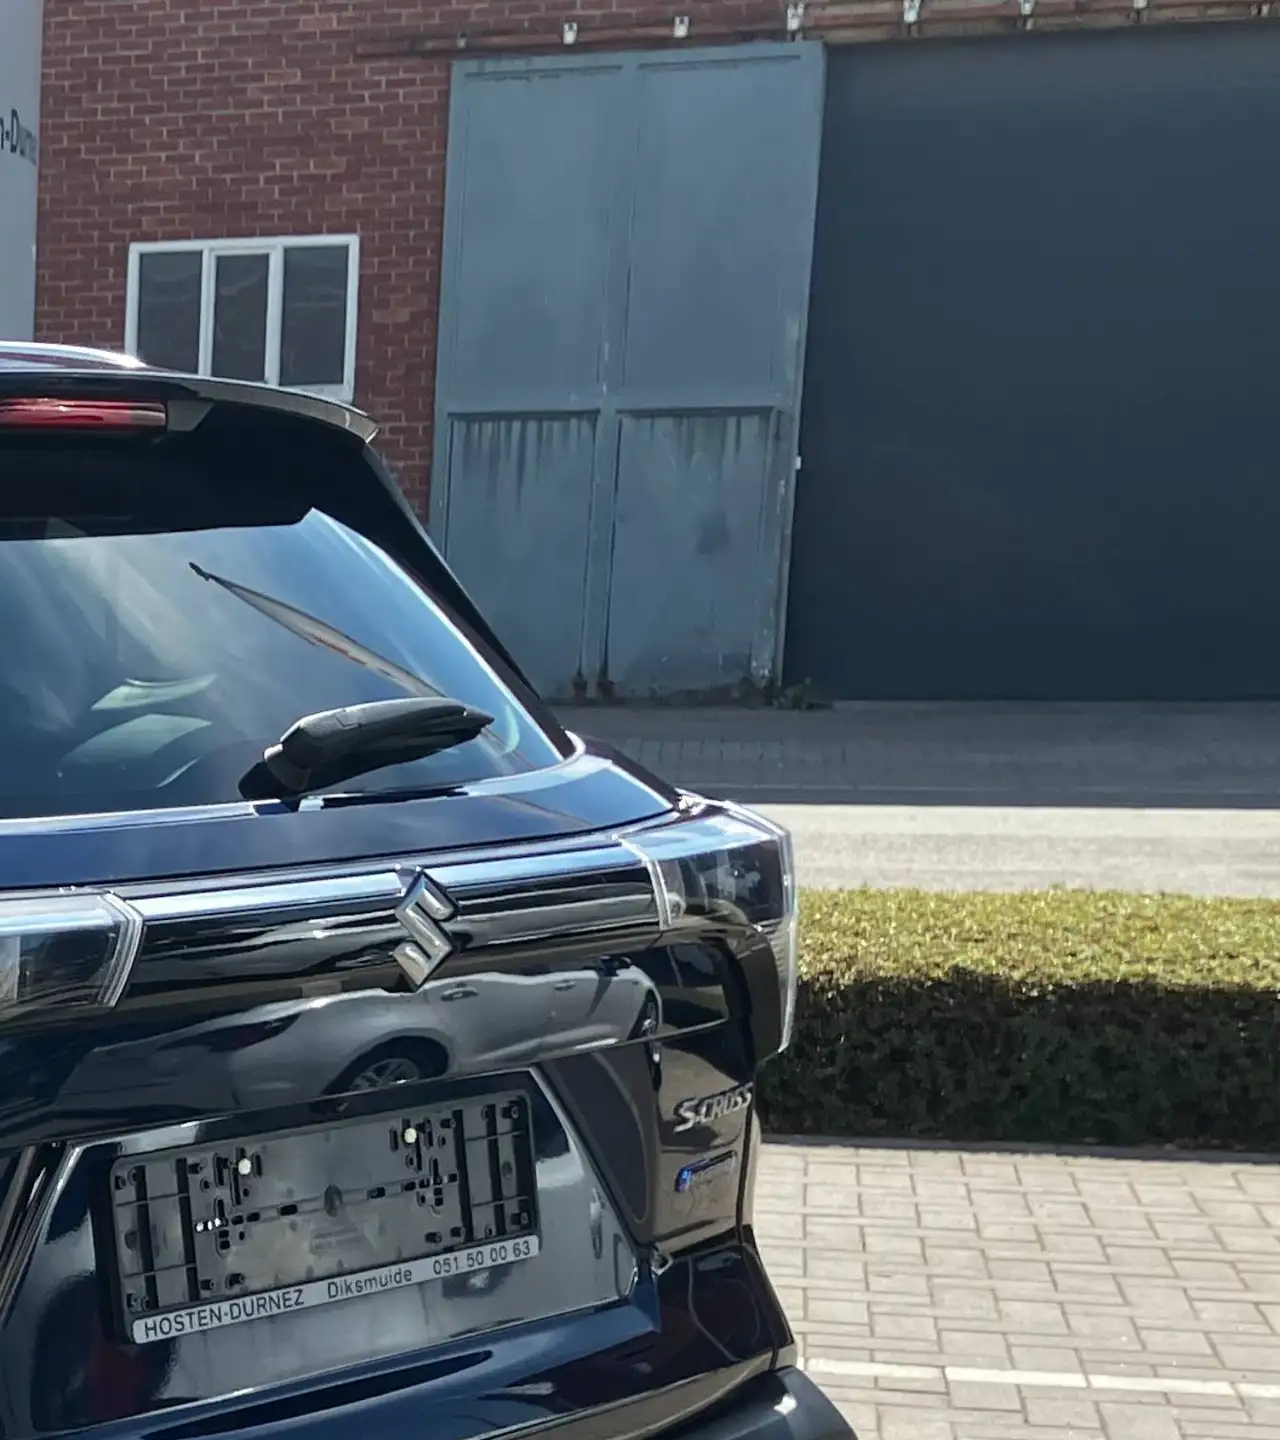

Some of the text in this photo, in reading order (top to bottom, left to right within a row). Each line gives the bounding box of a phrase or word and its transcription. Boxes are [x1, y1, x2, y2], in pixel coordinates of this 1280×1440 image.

[144, 1239, 531, 1340] HOSTEN-DURNEZ Diksmuide 051 50 00 63
